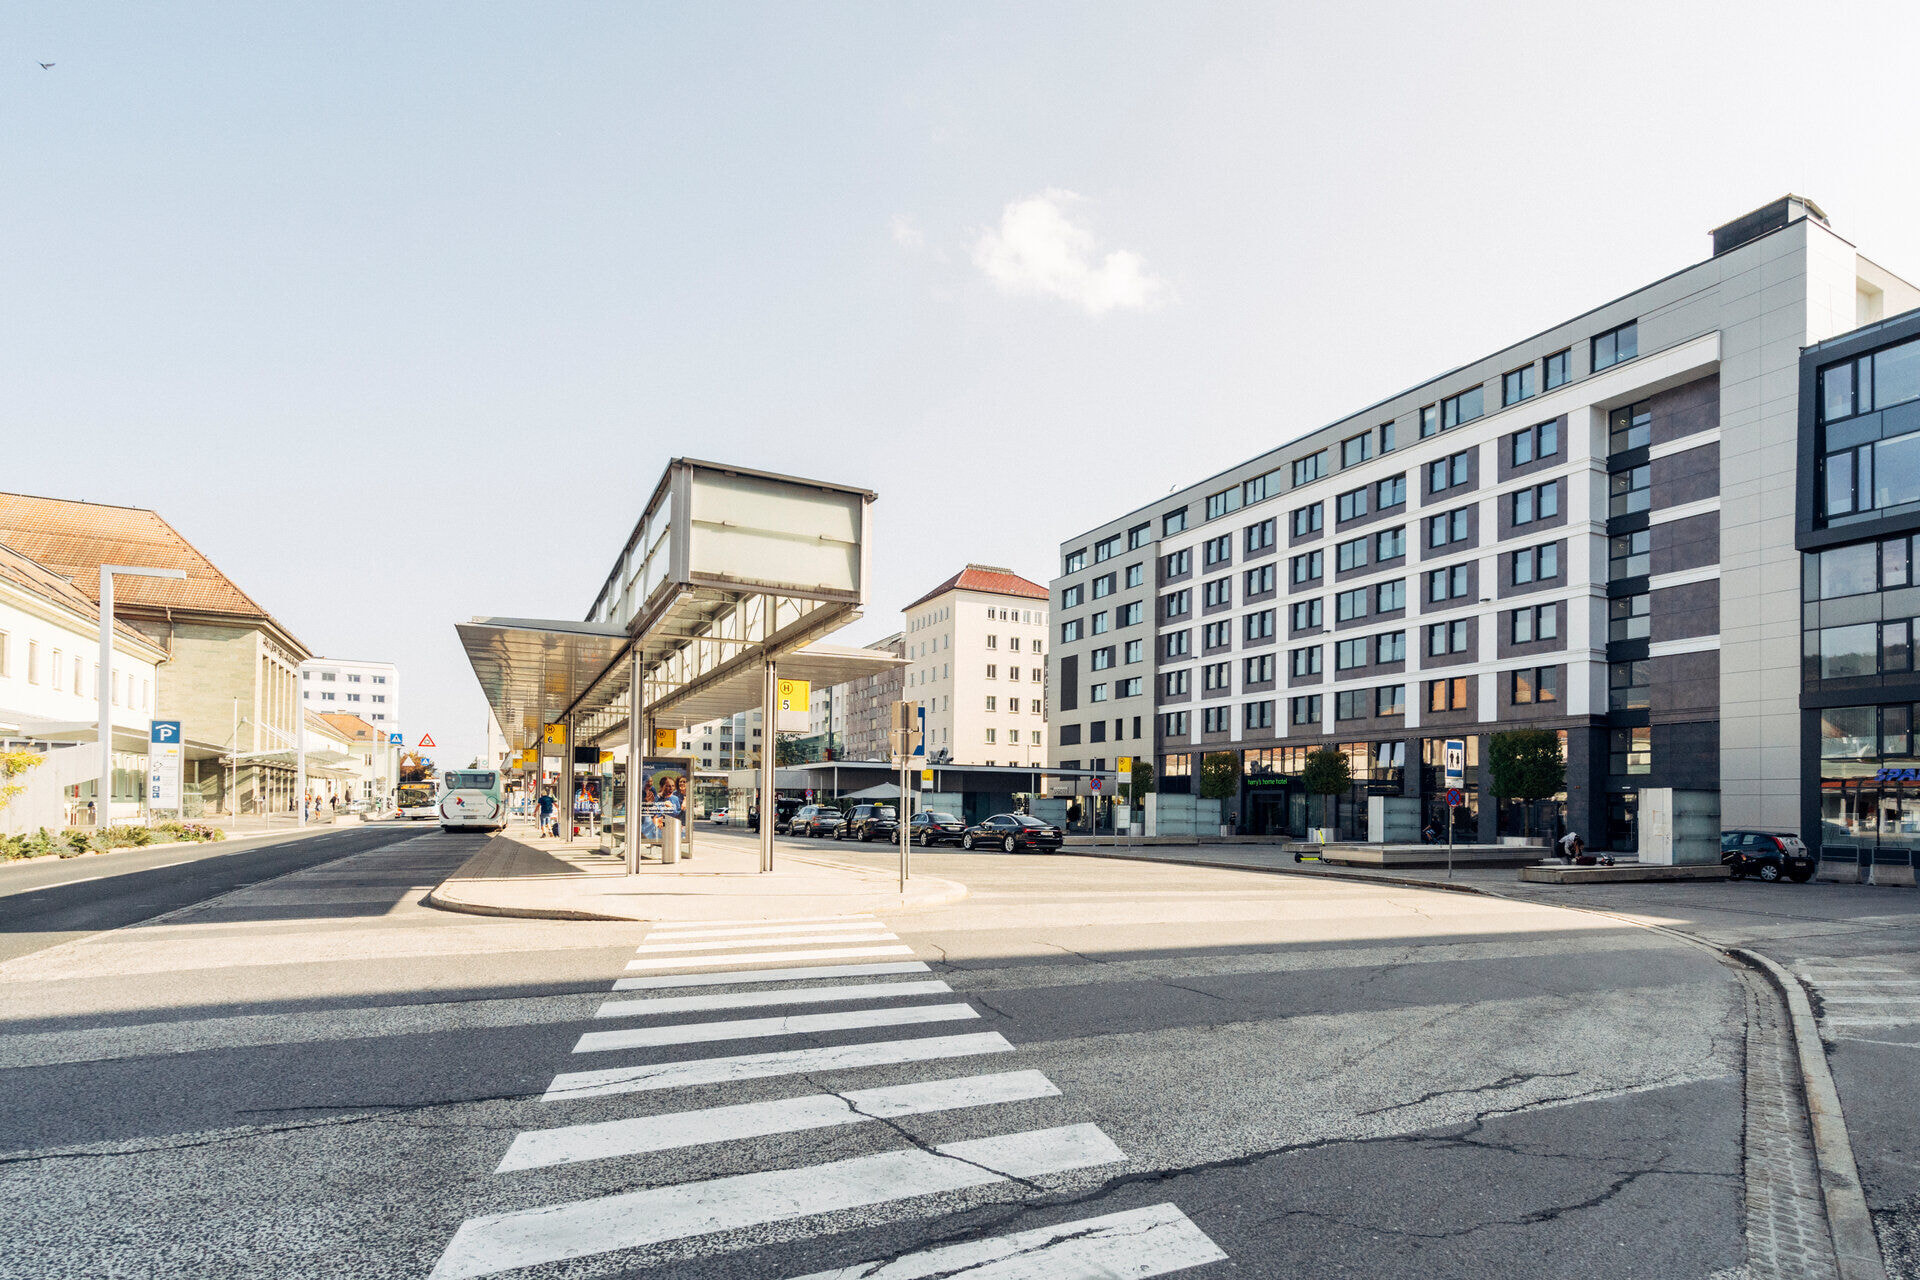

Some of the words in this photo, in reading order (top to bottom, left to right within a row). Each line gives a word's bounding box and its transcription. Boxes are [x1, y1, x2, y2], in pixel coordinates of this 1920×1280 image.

[782, 699, 790, 710] 5
[160, 728, 173, 741] P
[1874, 768, 1920, 781] SPA
